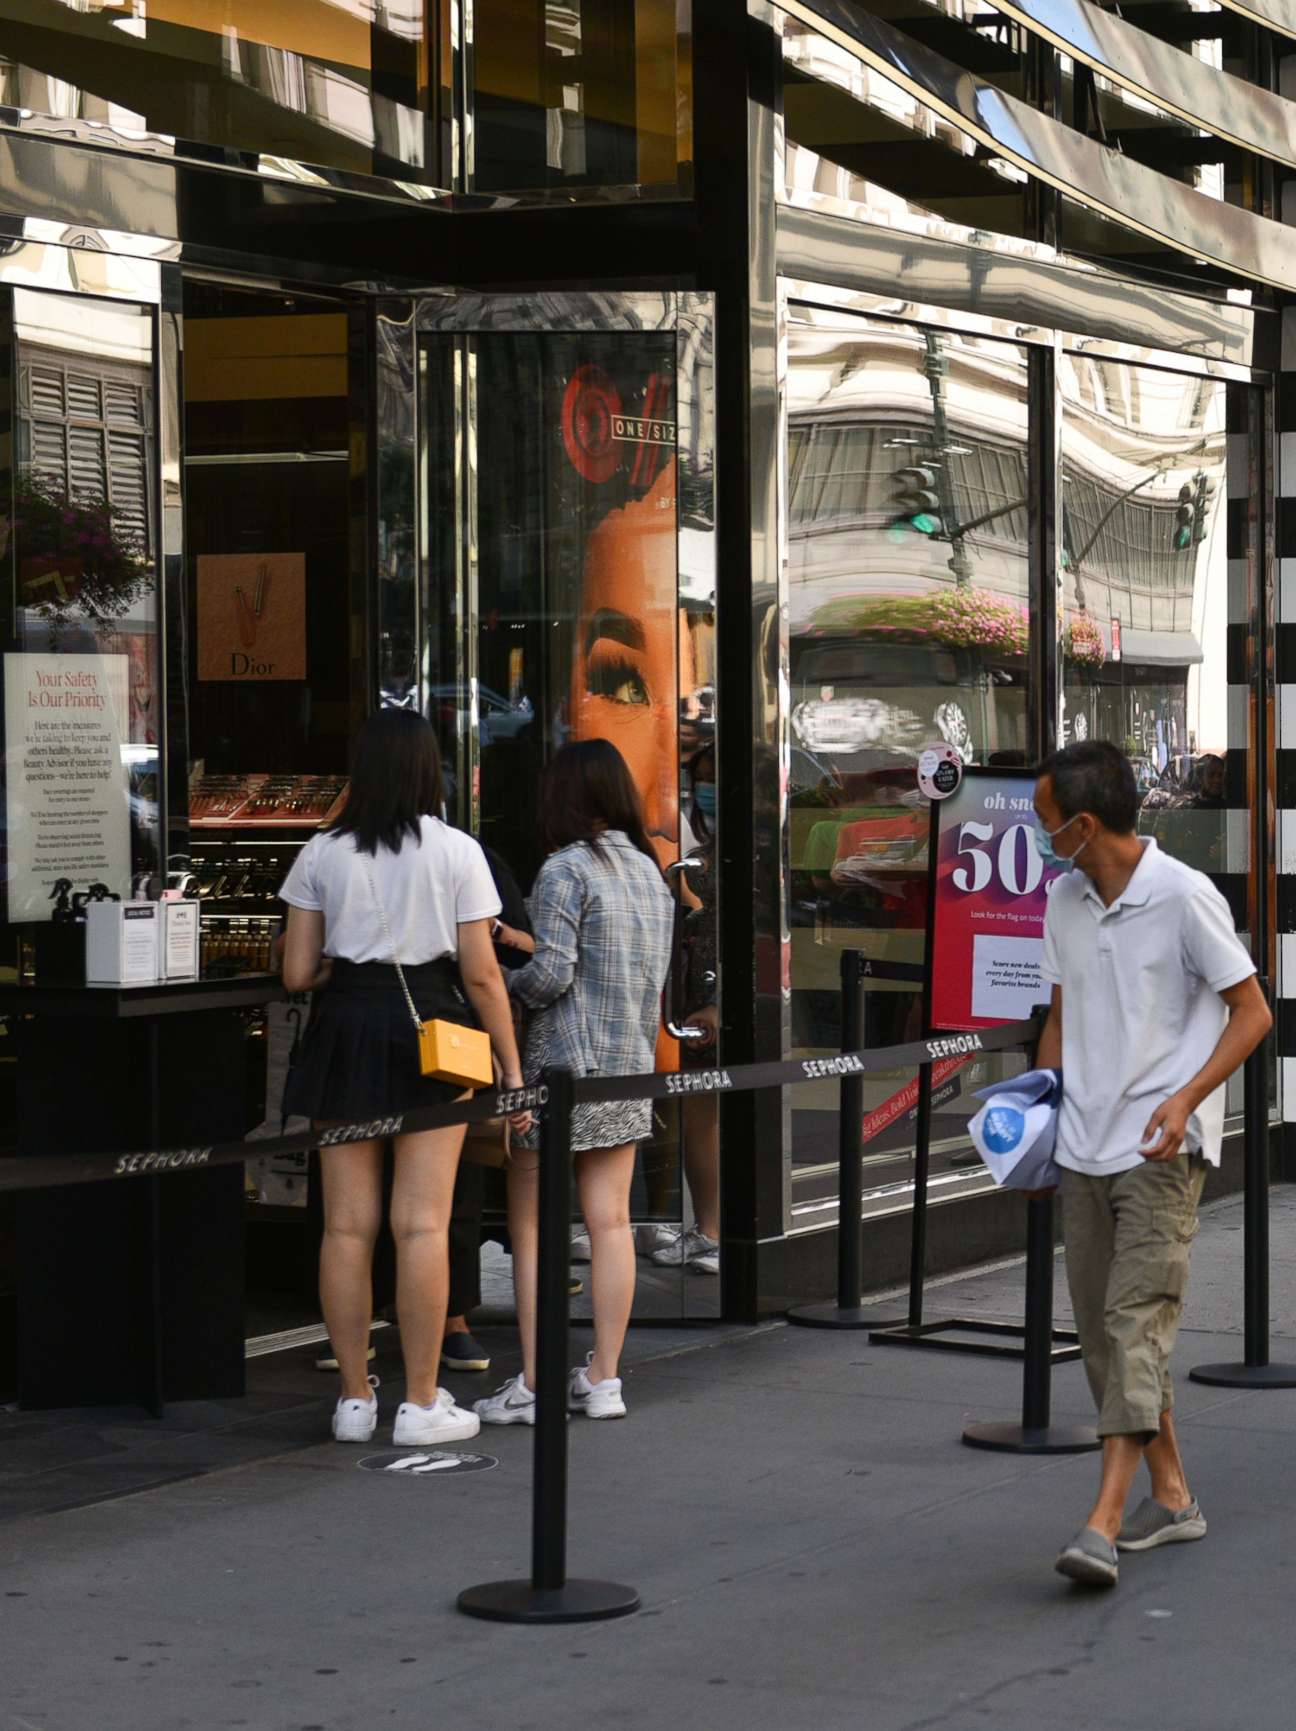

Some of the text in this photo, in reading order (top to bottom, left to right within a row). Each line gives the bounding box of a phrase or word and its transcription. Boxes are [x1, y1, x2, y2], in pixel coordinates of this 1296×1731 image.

[230, 652, 274, 675] Dior
[36, 670, 98, 691] Your Safety
[28, 690, 106, 711] Is Our Priority
[984, 792, 1033, 811] oh sn
[953, 820, 1043, 895] 50
[971, 911, 986, 919] Look
[987, 911, 996, 919] for
[996, 912, 1007, 920] the
[1008, 912, 1019, 922] flag
[1029, 913, 1043, 923] toda
[985, 969, 1001, 977] every
[1003, 970, 1014, 979] day
[1015, 970, 1030, 980] from
[926, 1034, 983, 1058] SEPHORA
[802, 1055, 865, 1079] SEPHORA
[665, 1070, 732, 1094] SEPHORA
[317, 1116, 403, 1146] SEPHORA
[113, 1146, 213, 1175] SEPHORA
